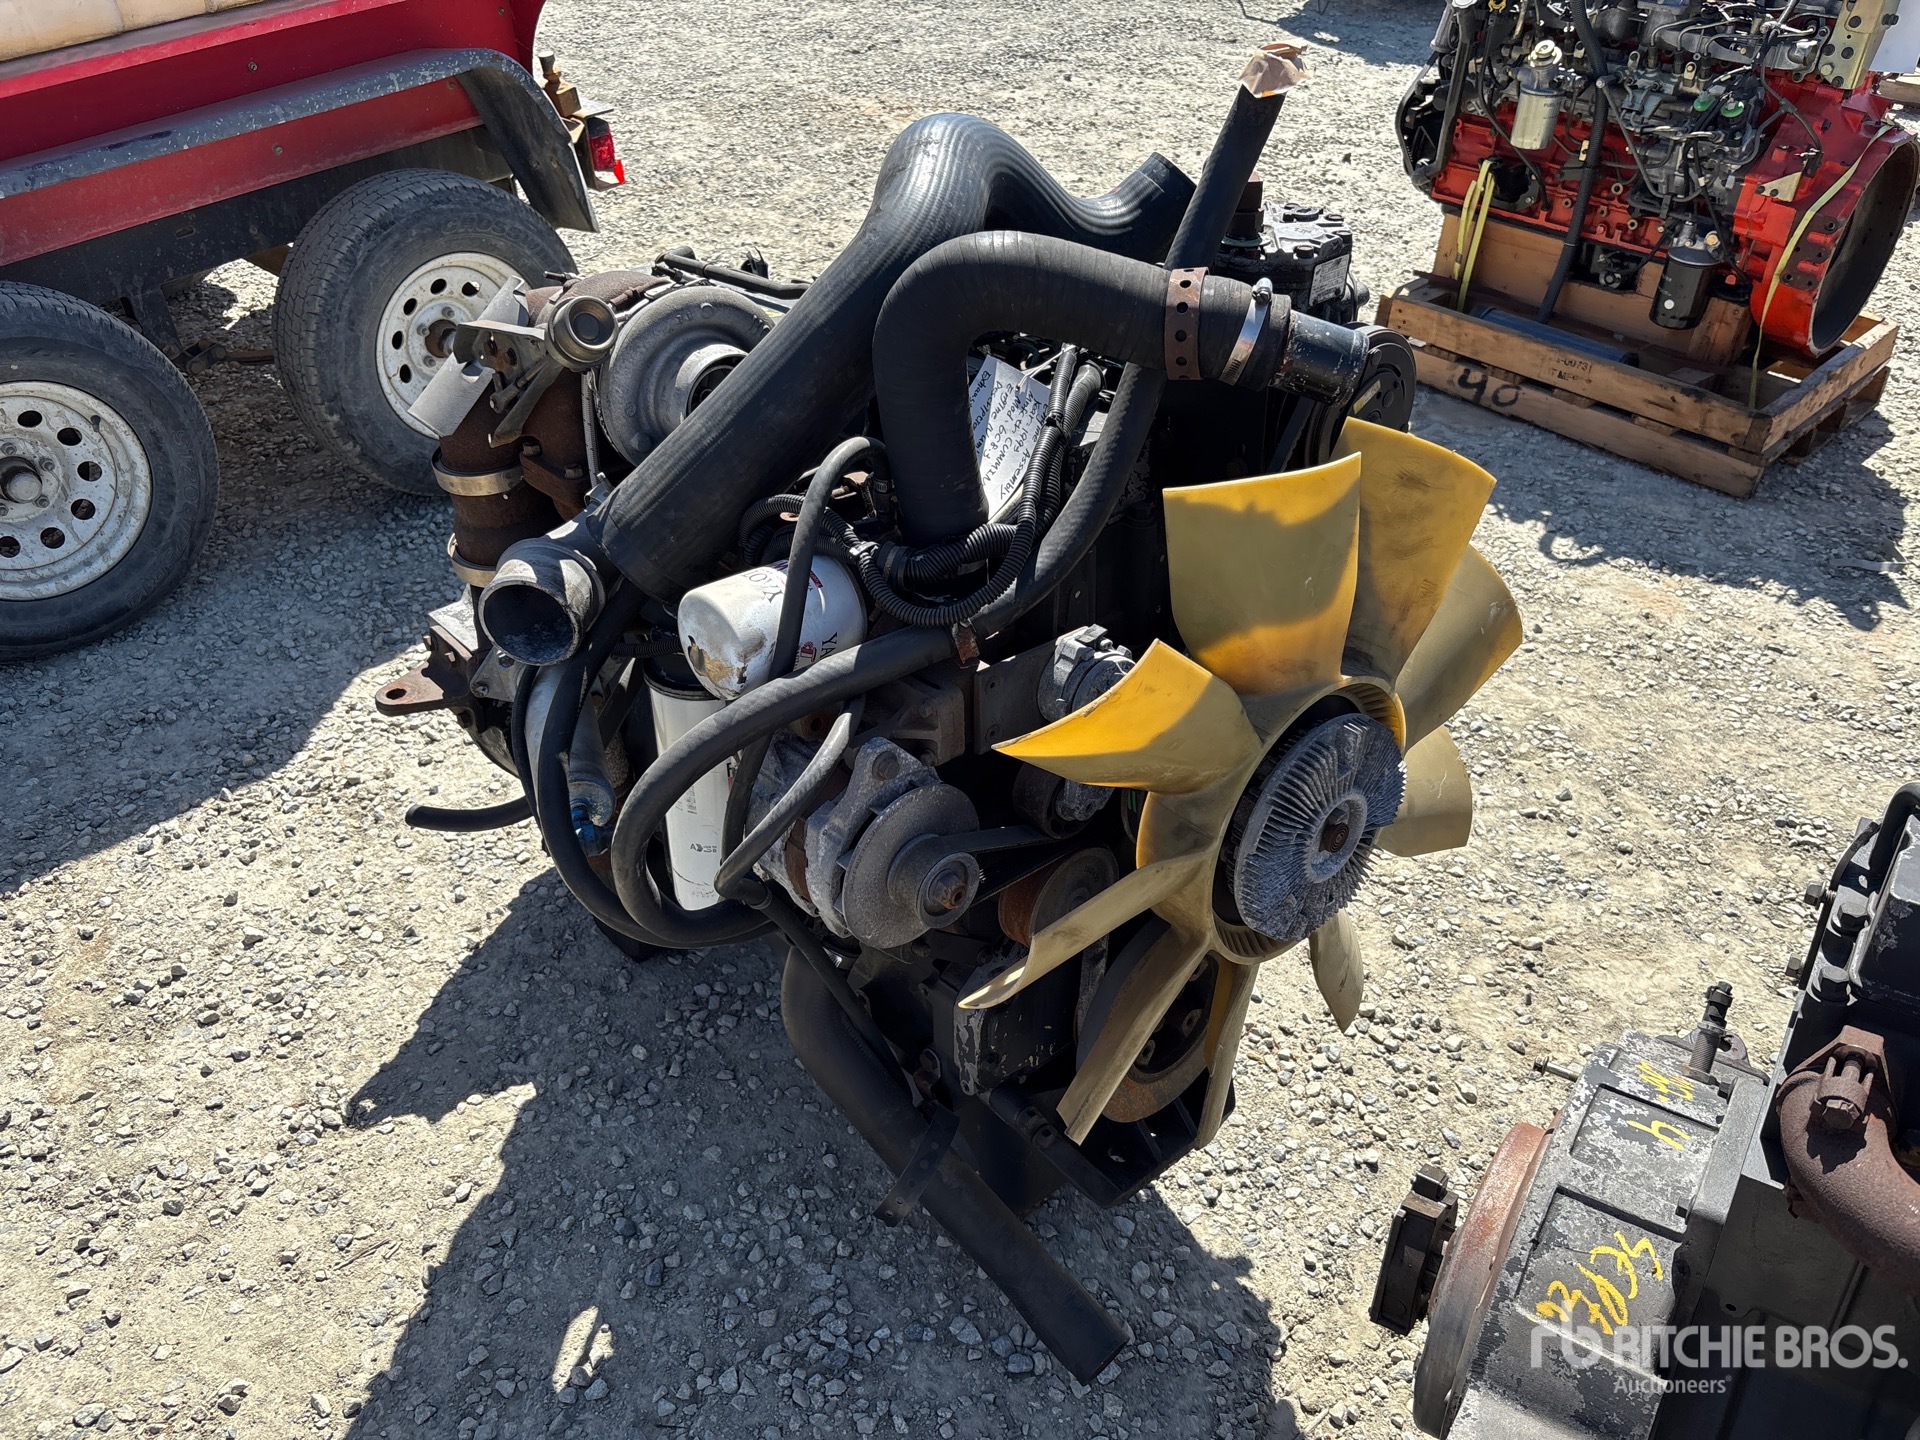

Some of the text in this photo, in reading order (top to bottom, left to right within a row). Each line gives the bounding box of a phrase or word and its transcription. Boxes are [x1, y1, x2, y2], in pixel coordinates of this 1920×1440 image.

[973, 381, 1003, 431] Descriptio
[1458, 368, 1521, 407] 40
[975, 422, 993, 453] Num
[1000, 448, 1031, 500] Assembly
